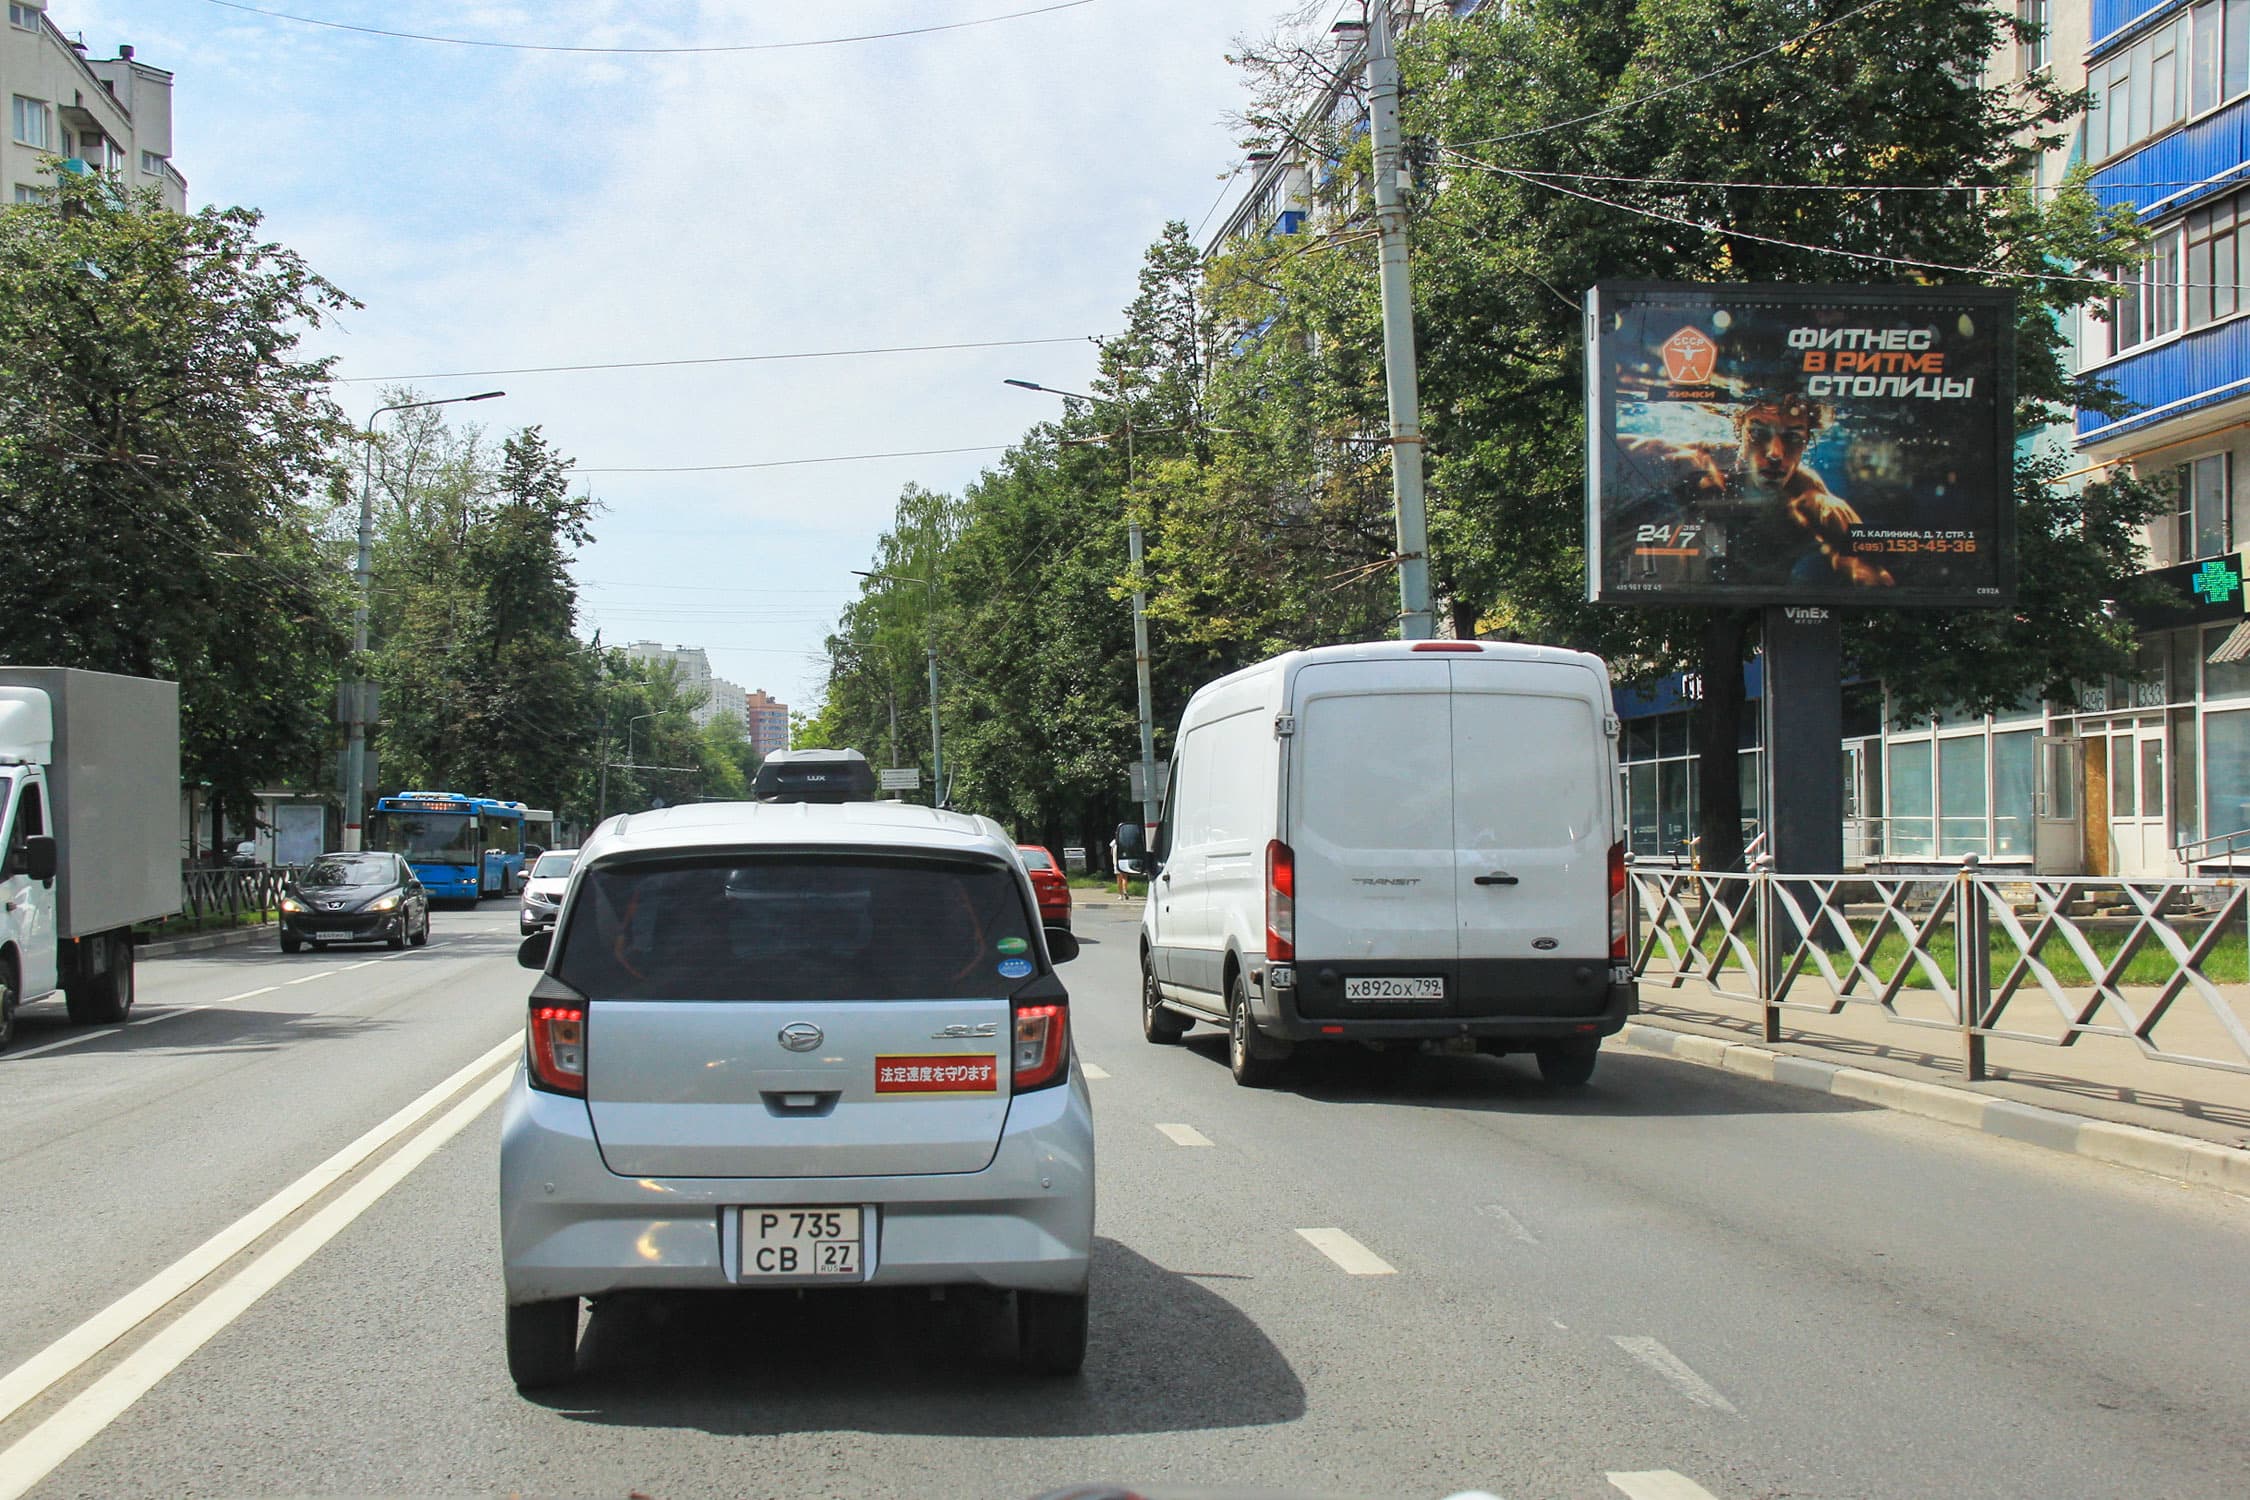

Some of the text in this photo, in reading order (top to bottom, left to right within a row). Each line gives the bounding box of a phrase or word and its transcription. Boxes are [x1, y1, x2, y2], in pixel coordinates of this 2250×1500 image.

[1673, 337, 1704, 346] СССР
[1787, 327, 1932, 350] ФИТНЕС
[1803, 352, 1944, 373] В РИТМЕ
[1808, 376, 1974, 400] СТОЛИЦЫ
[1636, 524, 1696, 549] 24/7
[1851, 530, 1866, 538] УЛ.
[1867, 530, 1921, 539] КАЛИНИНА,
[1924, 531, 1934, 539] Д.
[1945, 531, 1966, 539] СТР.
[1967, 531, 1975, 539] 1
[1887, 540, 1976, 552] 153-45-36
[1784, 607, 1829, 618] VinEx
[1415, 980, 1438, 991] 799
[881, 1066, 991, 1083] 法定速度を守ります
[790, 1213, 841, 1238] 735
[824, 1246, 850, 1264] 27
